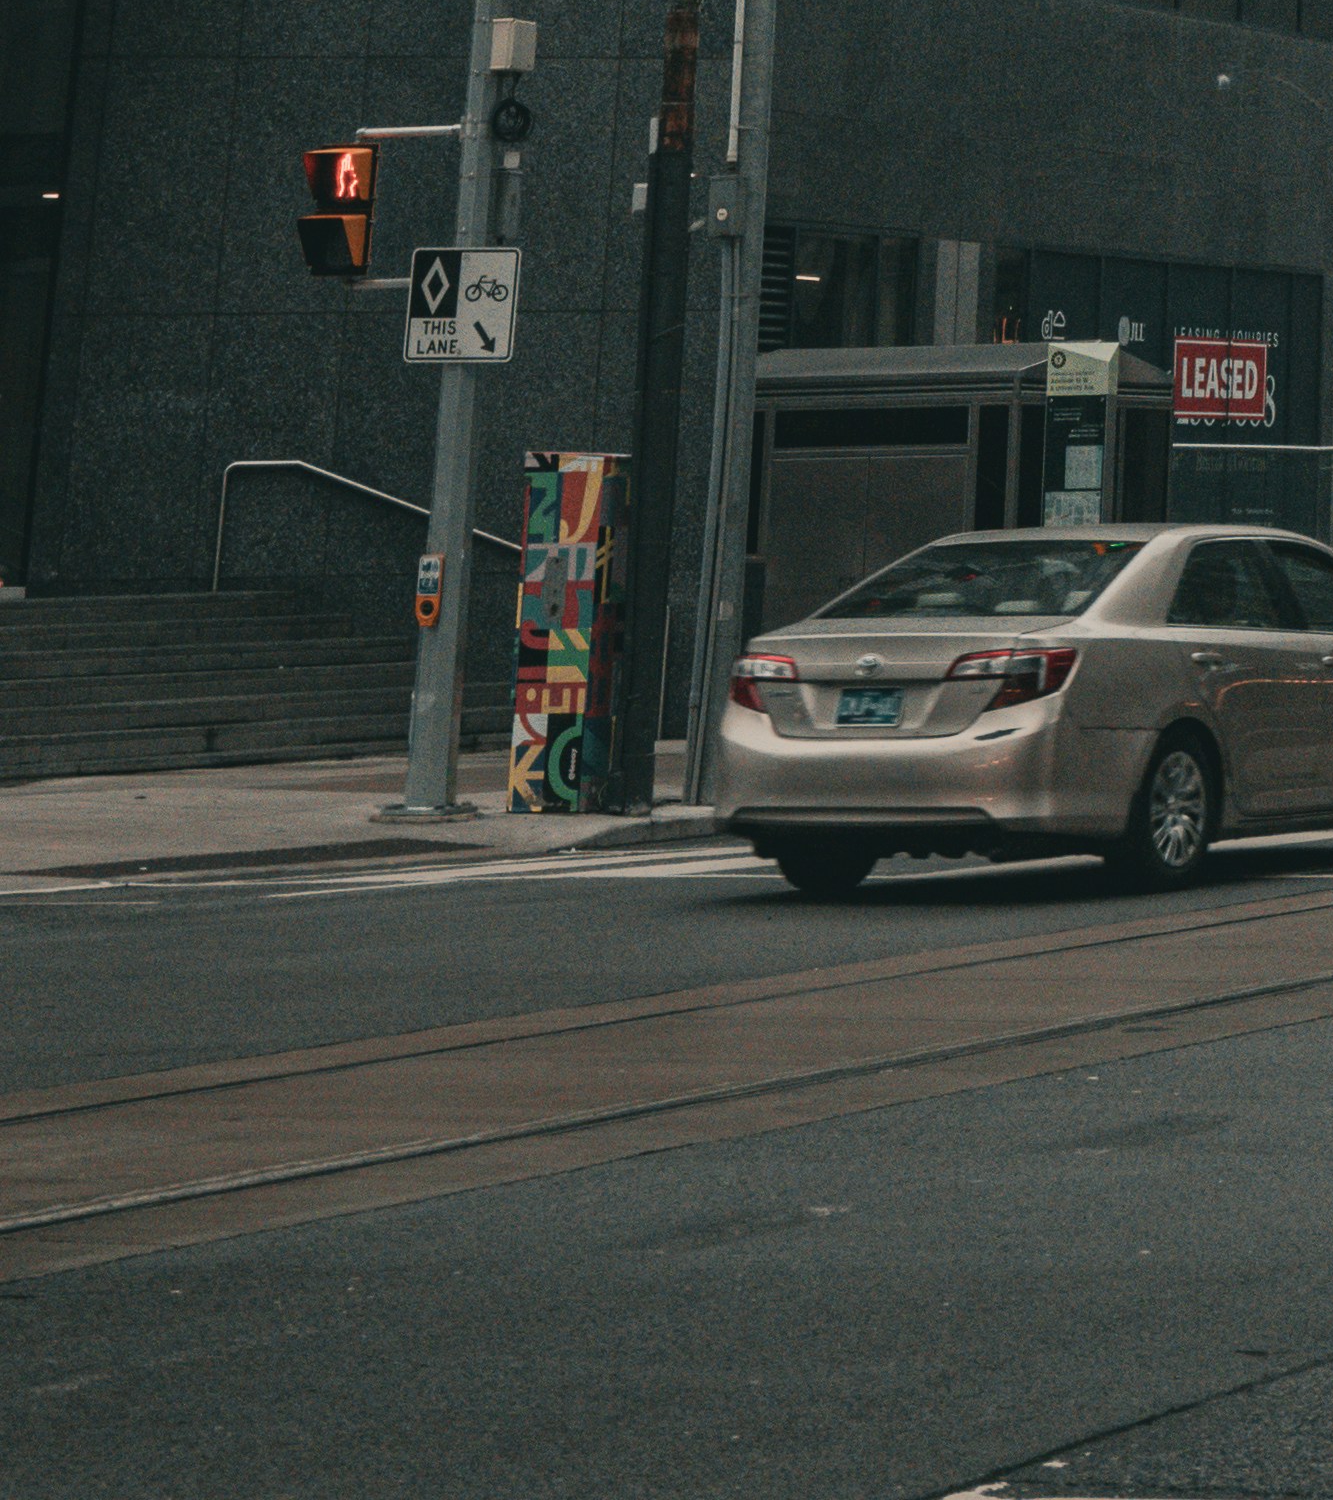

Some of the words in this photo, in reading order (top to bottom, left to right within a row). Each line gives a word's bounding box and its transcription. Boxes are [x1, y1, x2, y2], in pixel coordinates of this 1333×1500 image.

[422, 320, 457, 336] THIS
[416, 339, 458, 355] LANE
[1181, 357, 1259, 400] LEASED
